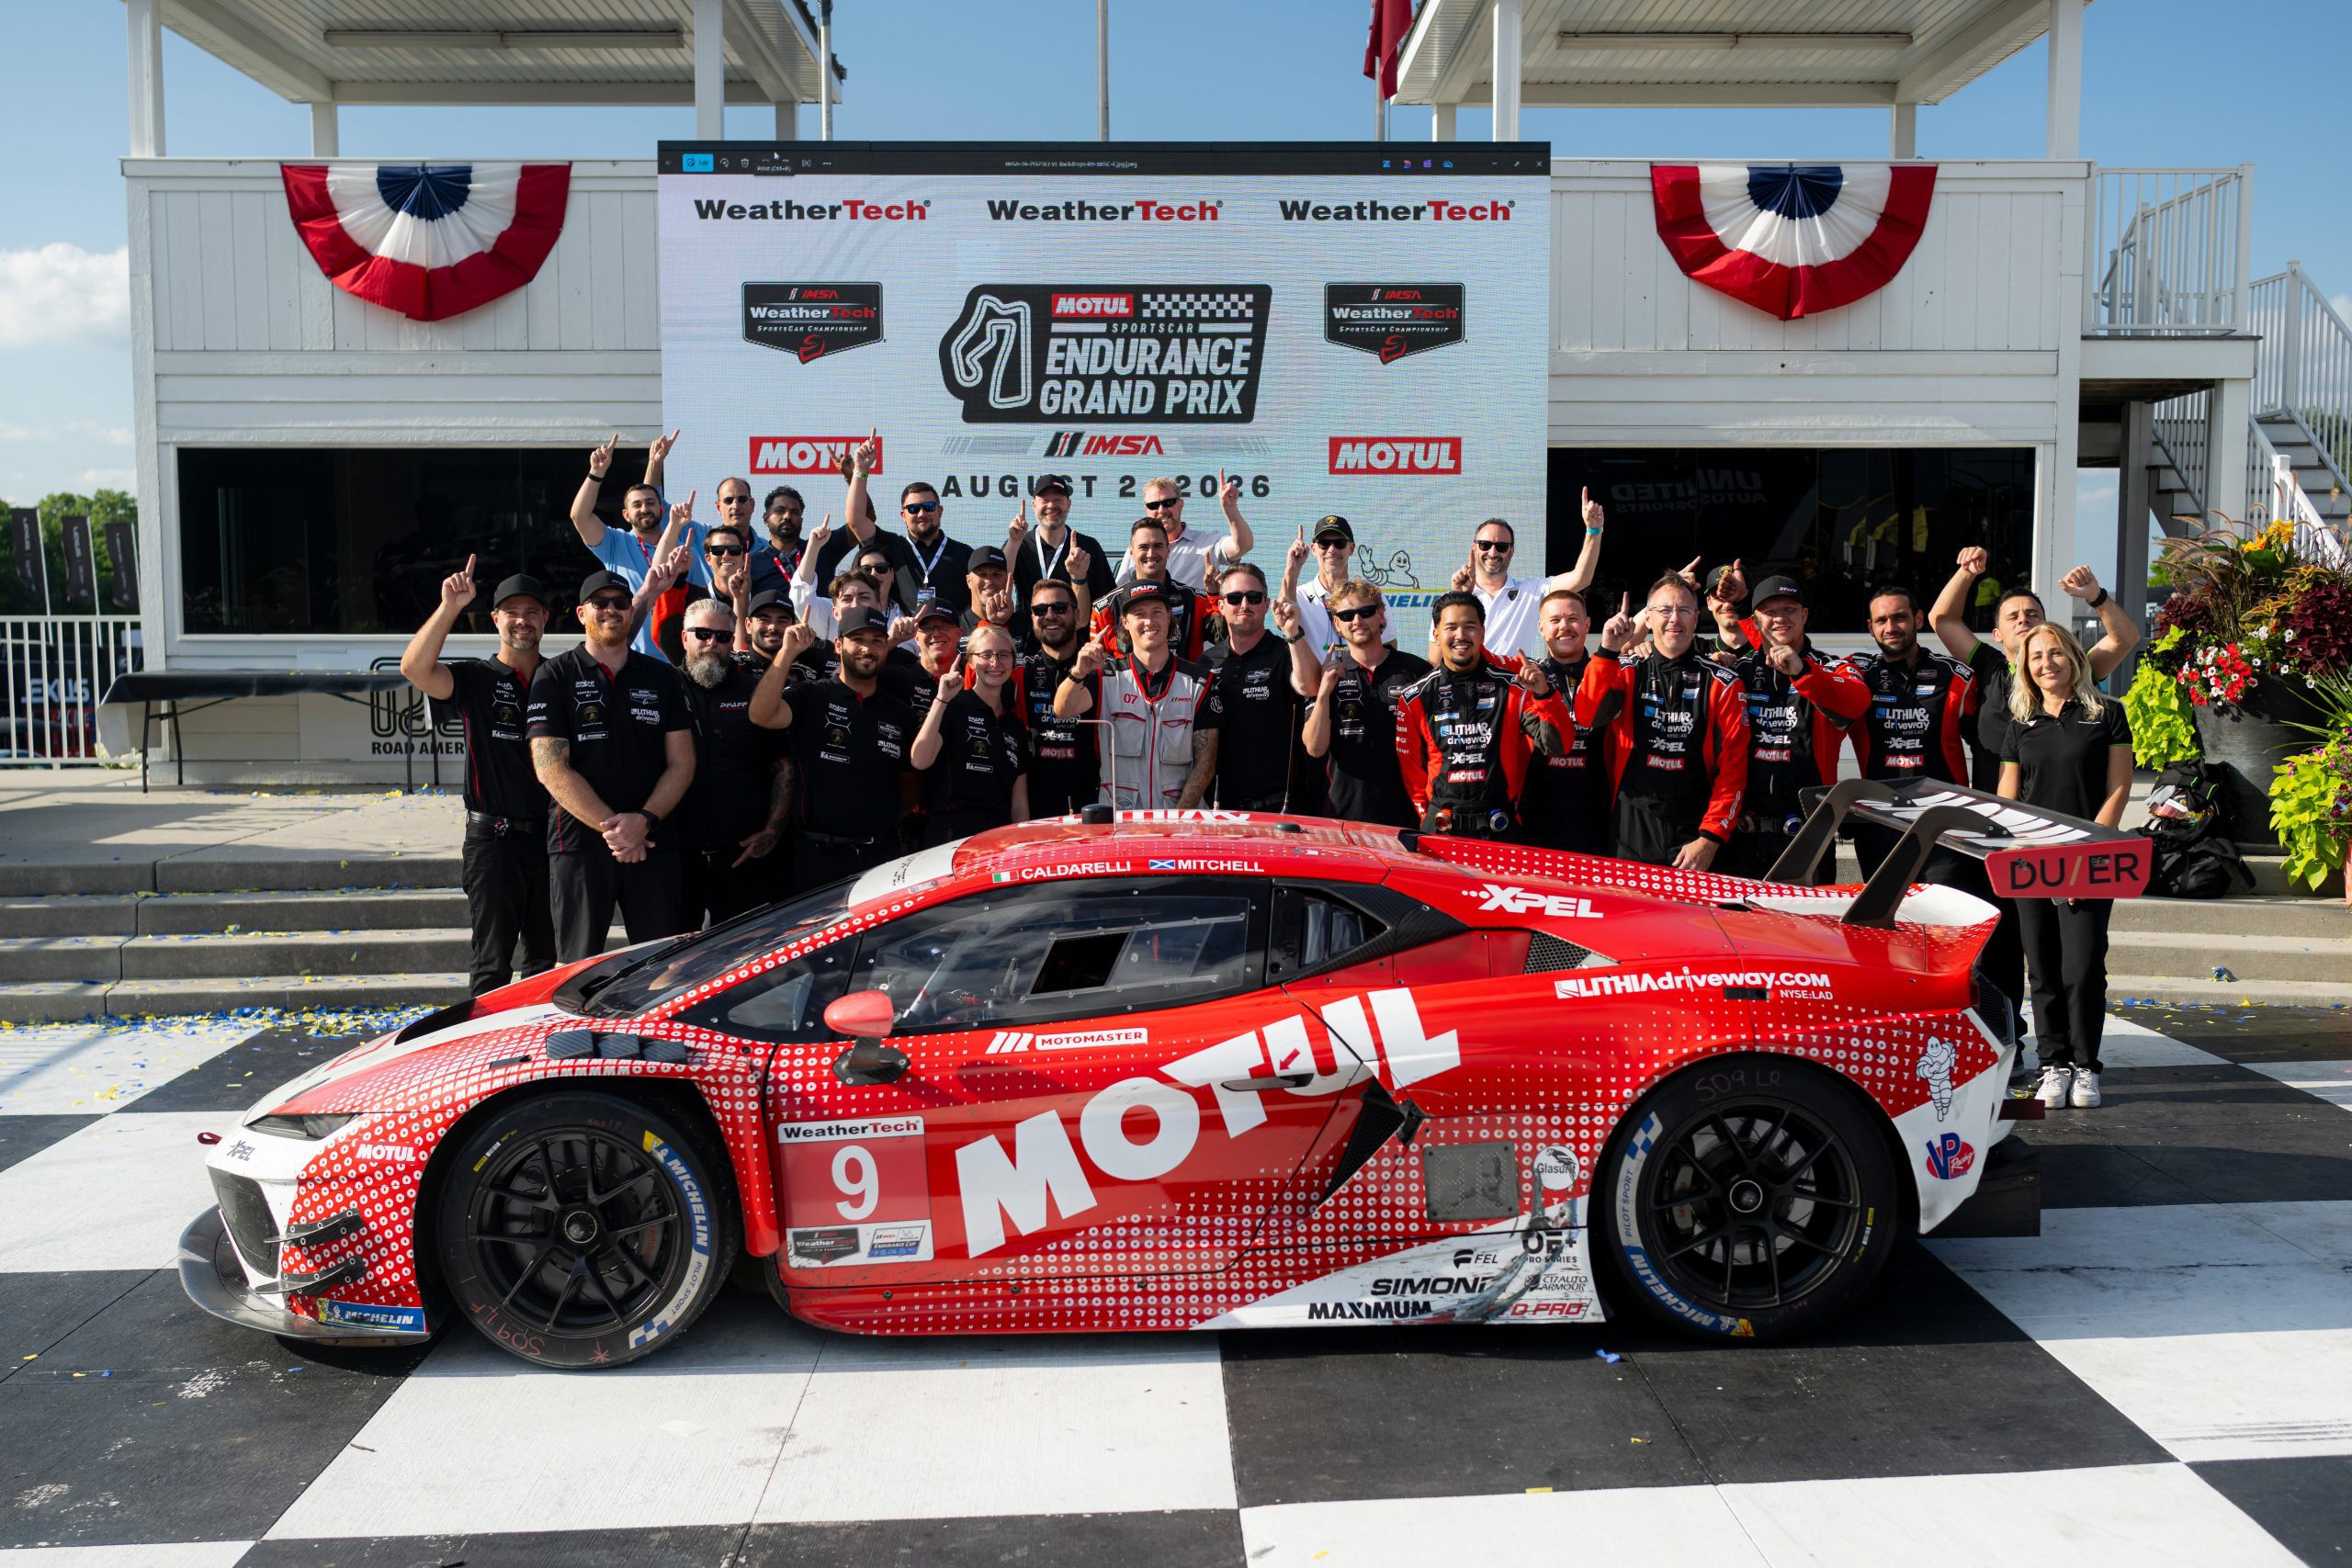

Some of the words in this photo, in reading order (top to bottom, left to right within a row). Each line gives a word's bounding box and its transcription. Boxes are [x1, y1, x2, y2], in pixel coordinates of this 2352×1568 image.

[801, 289, 839, 299] IMSA
[1385, 290, 1421, 300] IMSA
[750, 307, 876, 319] WeatherTech
[1056, 297, 1129, 314] MOTUL
[1332, 307, 1458, 319] WeatherTech
[1112, 323, 1193, 333] SPORTSCAR
[1046, 337, 1253, 375] ENDURANCE
[1039, 379, 1156, 415] GRAND
[1164, 379, 1242, 414] PRIX
[1082, 434, 1164, 456] IMSA
[755, 442, 877, 469] MOTU
[1334, 442, 1456, 470] MOTUL
[1131, 584, 1158, 593] PFAFF
[1124, 693, 1138, 705] 07
[1885, 707, 1930, 722] LITHIA&
[1448, 722, 1492, 737] LITHIA&
[1883, 719, 1930, 731] driveway
[371, 741, 415, 754] ROAD
[419, 741, 465, 754] AMER
[1447, 735, 1492, 746] driveway
[1571, 739, 1588, 750] EL
[1040, 748, 1073, 757] MOTUL
[1756, 750, 1789, 761] MOTUL
[1549, 757, 1585, 766] MOTUL
[1648, 756, 1683, 769] MOTUL
[1886, 756, 1922, 766] MOTUL
[1449, 771, 1484, 781] MOTUL
[1021, 860, 1131, 880] CALDARELLI
[1178, 859, 1264, 873] MITCHELL
[2010, 852, 2139, 890] DU/ER
[1477, 884, 1603, 919] XPEL
[1779, 989, 1834, 1001] NYSE:LAD
[1041, 1030, 1143, 1046] MOTOMASTER
[783, 1120, 919, 1140] WeatherTech
[956, 987, 1461, 1258] MOTUL
[356, 1144, 415, 1162] MOTUL
[1926, 1132, 1961, 1179] VP
[1537, 1162, 1576, 1174] Glasurt
[831, 1145, 879, 1221] 9
[1623, 1170, 1634, 1204] SPORT
[668, 1158, 708, 1247] MICHELIN
[1622, 1207, 1633, 1237] PILOT
[1473, 1253, 1499, 1265] FEL
[688, 1260, 703, 1288] PILOT
[1370, 1275, 1503, 1296] SIMONI
[1629, 1254, 1716, 1327] MICHELIN
[670, 1287, 692, 1315] SPORT
[1307, 1301, 1433, 1320] MAXIMUM
